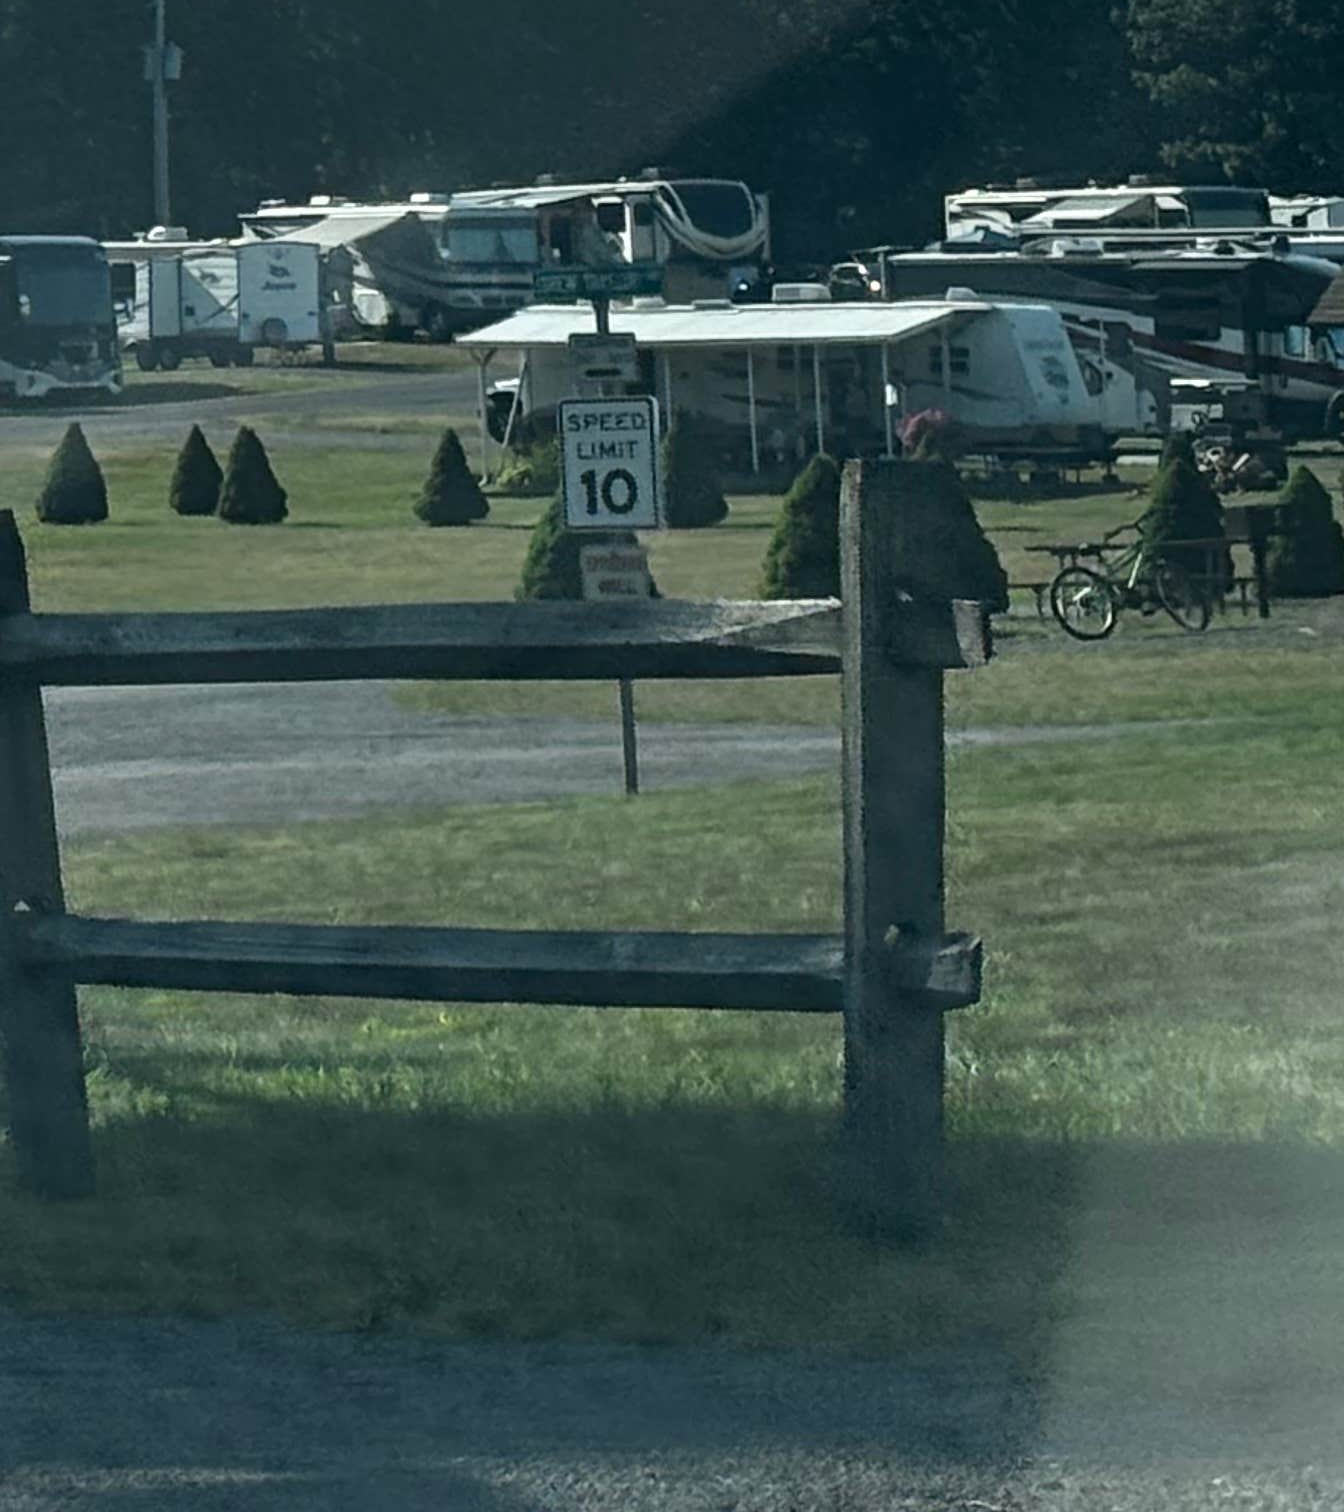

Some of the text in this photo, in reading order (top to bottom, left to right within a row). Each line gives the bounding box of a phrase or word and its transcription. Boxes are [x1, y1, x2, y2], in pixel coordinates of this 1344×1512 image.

[567, 412, 648, 432] SPEED
[577, 440, 639, 460] LIMIT
[579, 468, 639, 515] 10
